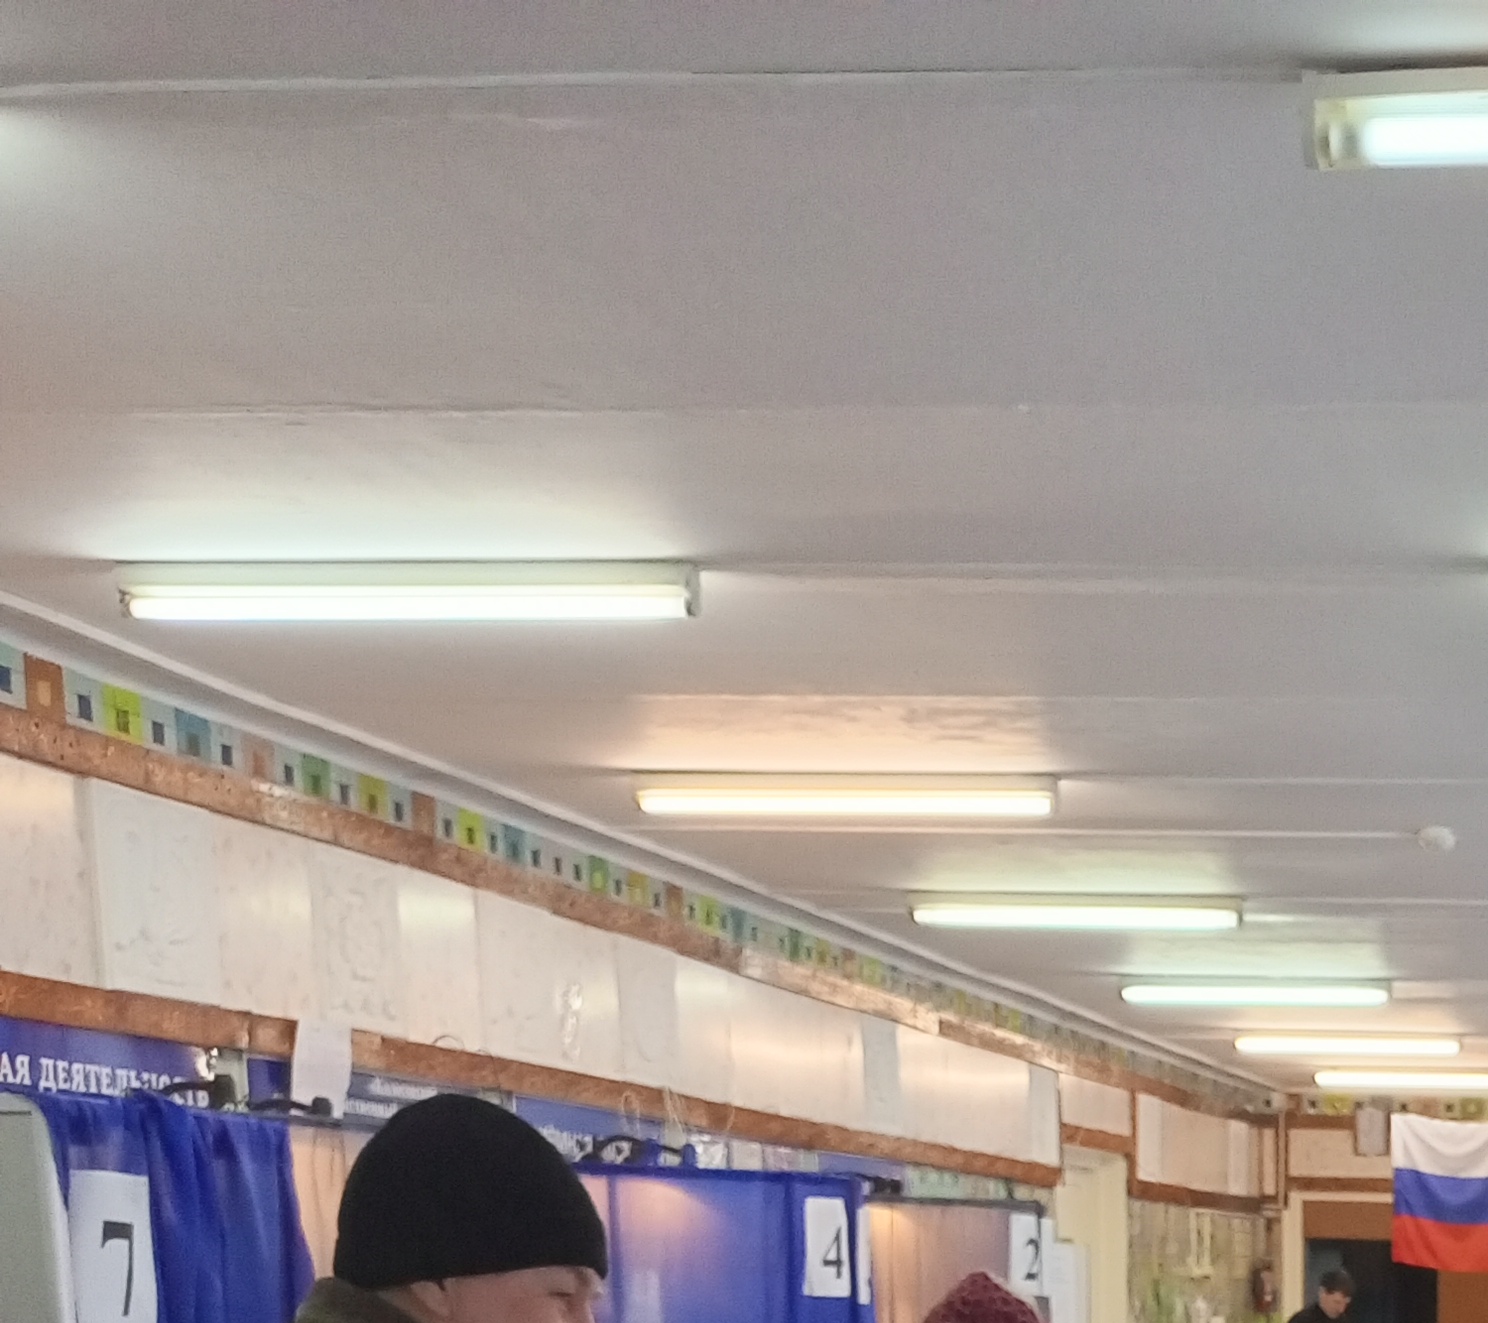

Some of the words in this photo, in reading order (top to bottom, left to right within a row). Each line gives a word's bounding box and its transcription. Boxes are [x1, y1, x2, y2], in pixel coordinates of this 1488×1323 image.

[101, 1220, 134, 1316] 7
[823, 1226, 842, 1279] 4
[1025, 1238, 1040, 1280] 2
